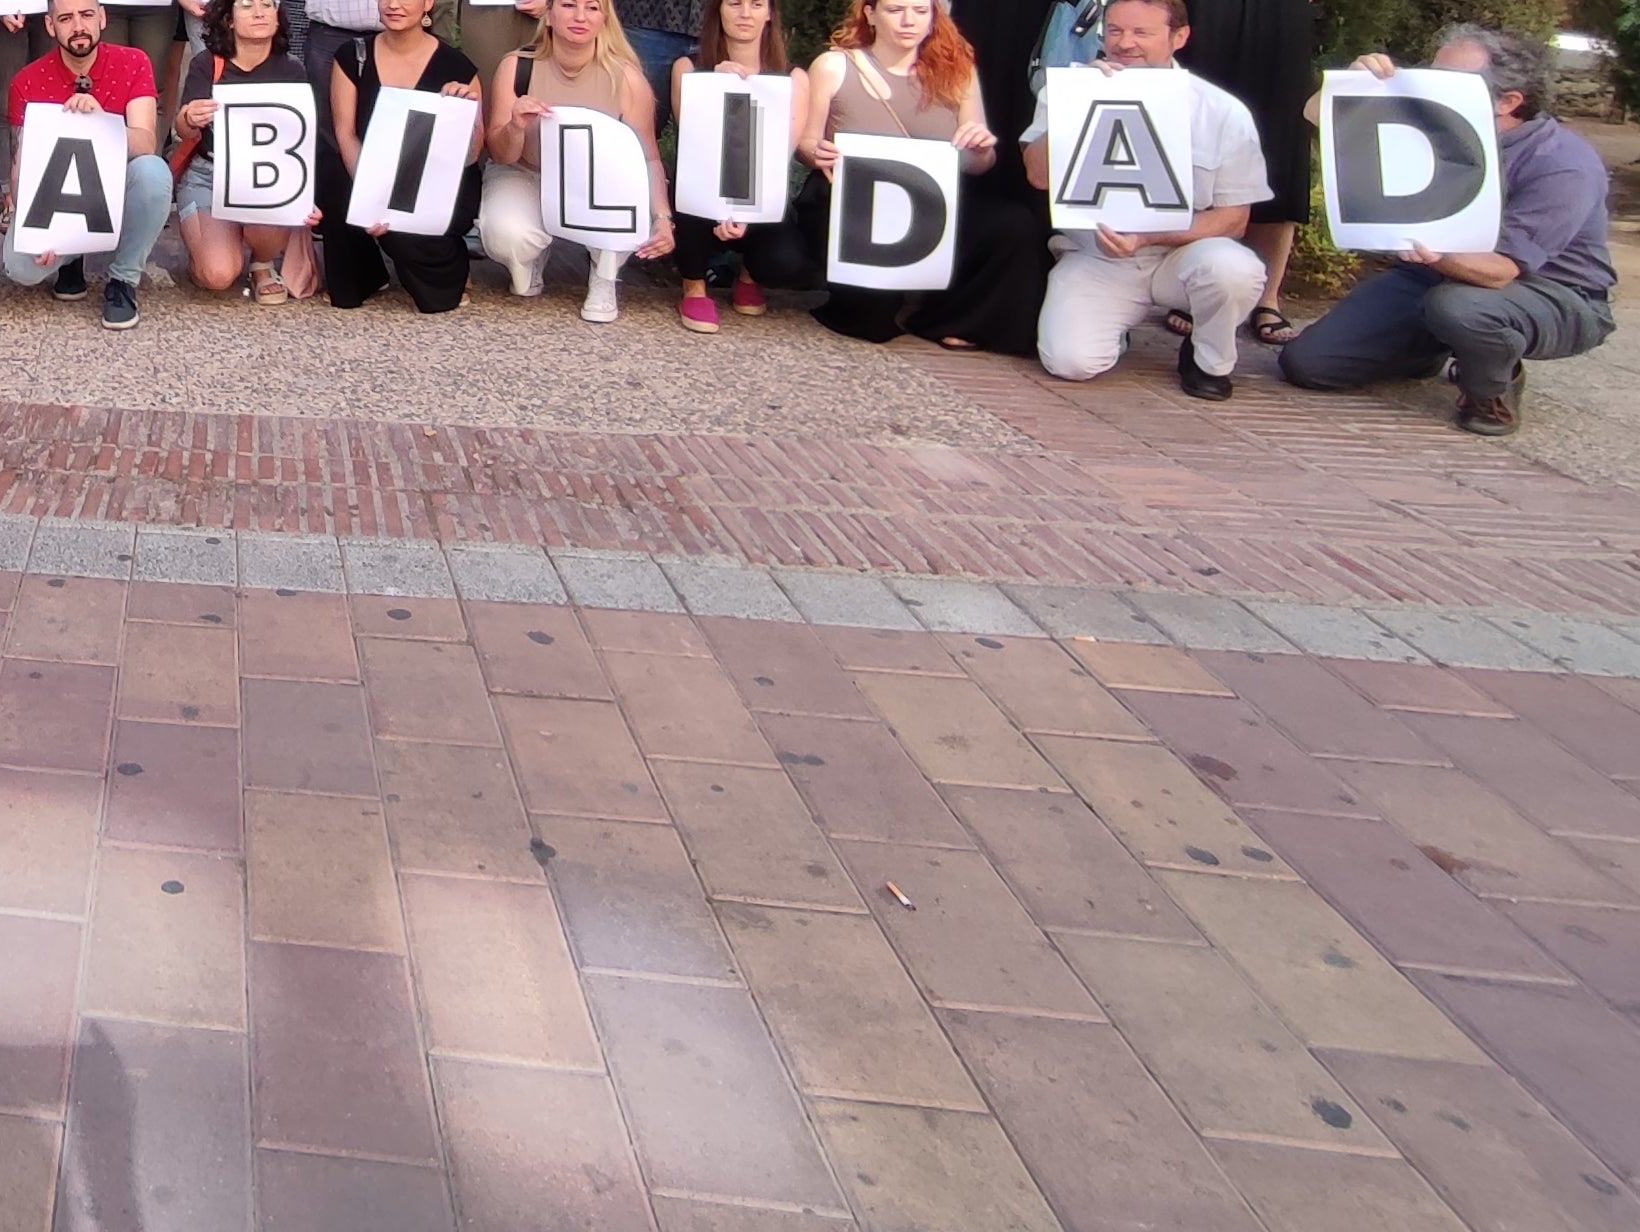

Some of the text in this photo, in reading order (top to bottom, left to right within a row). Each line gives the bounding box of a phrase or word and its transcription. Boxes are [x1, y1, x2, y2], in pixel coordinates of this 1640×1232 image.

[22, 137, 114, 234] A
[222, 102, 308, 209] B
[387, 110, 437, 212] I
[559, 124, 636, 233] L
[718, 92, 765, 205] I
[1056, 100, 1188, 211] A
[1333, 95, 1486, 225] D
[838, 155, 948, 268] D
